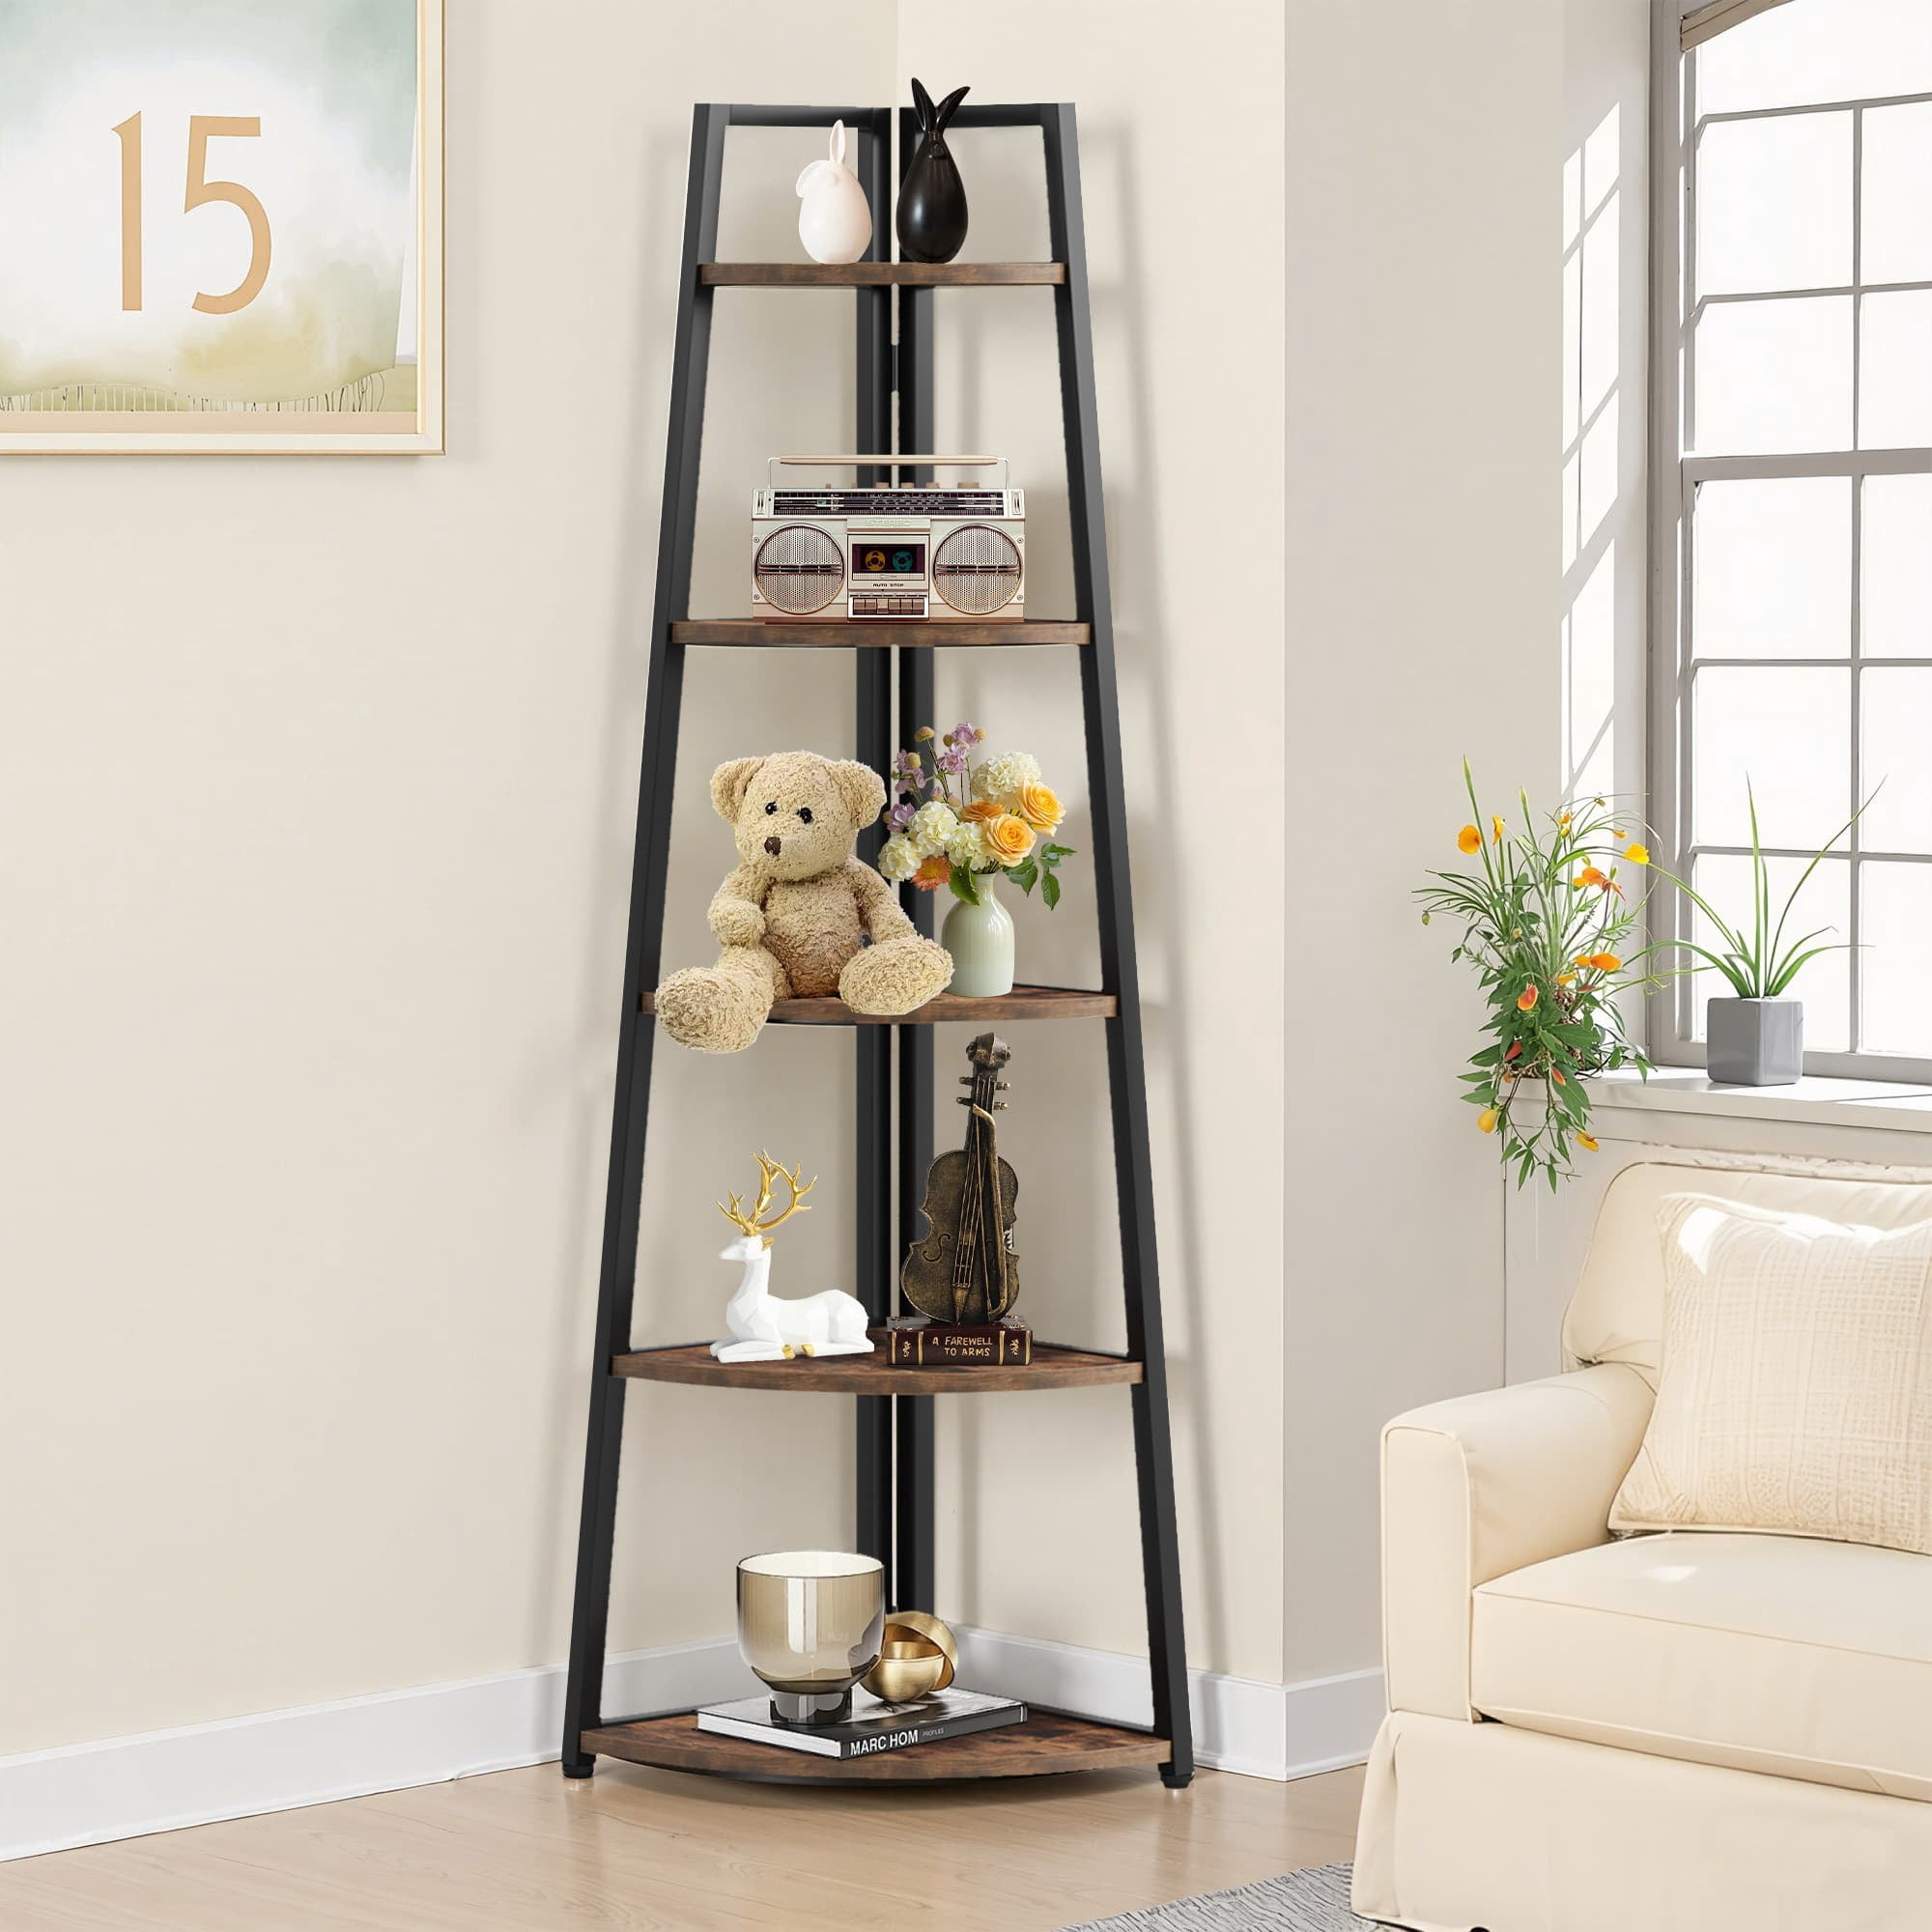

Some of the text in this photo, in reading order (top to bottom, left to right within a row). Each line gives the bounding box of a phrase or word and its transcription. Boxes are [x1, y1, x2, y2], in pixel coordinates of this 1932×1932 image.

[111, 110, 271, 315] 15
[932, 1336, 993, 1346] A FAREWELL
[944, 1347, 990, 1356] TO ARMS
[850, 1735, 887, 1756] MARC
[889, 1729, 919, 1747] HOM
